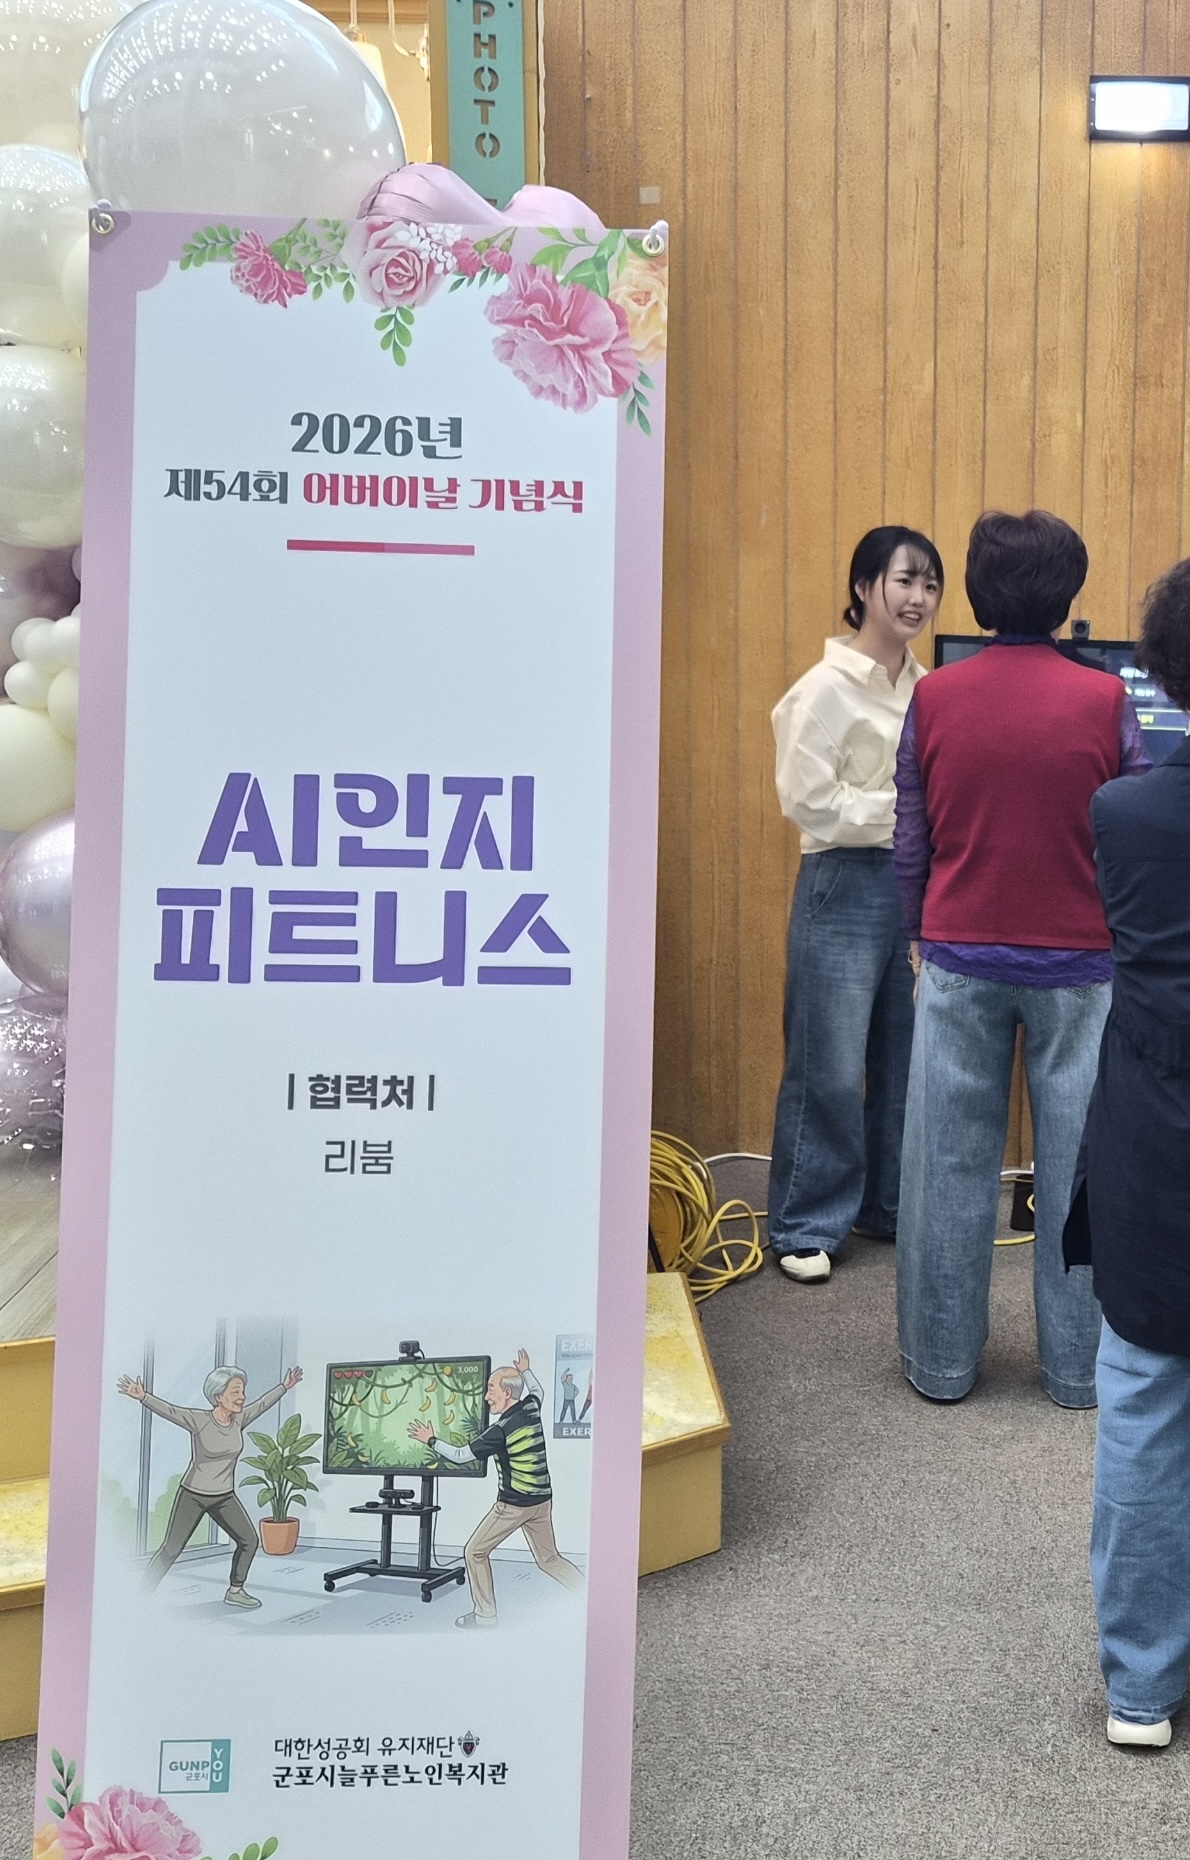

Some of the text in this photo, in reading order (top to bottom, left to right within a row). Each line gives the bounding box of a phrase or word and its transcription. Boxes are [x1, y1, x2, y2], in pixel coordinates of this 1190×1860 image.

[472, 0, 501, 159] PHOTO
[290, 411, 463, 460] 2026년
[163, 467, 584, 514] 제54회 어버이날 기념식
[196, 772, 535, 872] AI인지
[153, 886, 572, 987] 피트니스
[324, 1139, 394, 1175] 리붐
[457, 1365, 479, 1375] 3,000
[274, 1735, 455, 1761] 대한성공회 유지재단
[272, 1762, 509, 1789] 군포시늘푸른노인복지관
